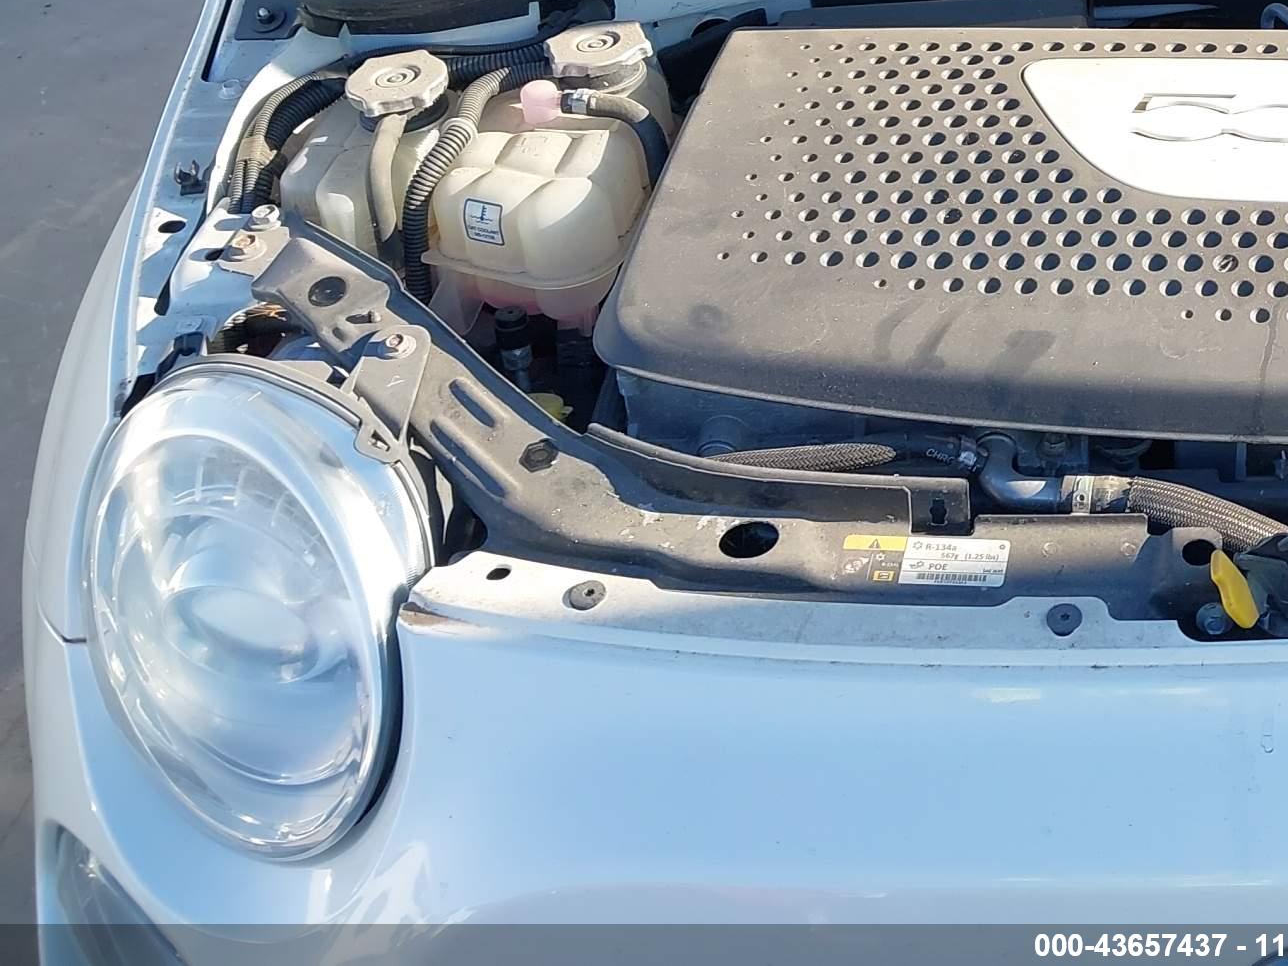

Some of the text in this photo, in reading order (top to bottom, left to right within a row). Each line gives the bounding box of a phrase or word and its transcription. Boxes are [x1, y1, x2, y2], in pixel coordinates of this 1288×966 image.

[925, 543, 957, 552] R-134a
[940, 552, 959, 560] 567g
[964, 553, 984, 561] (1.25
[928, 563, 948, 571] POE
